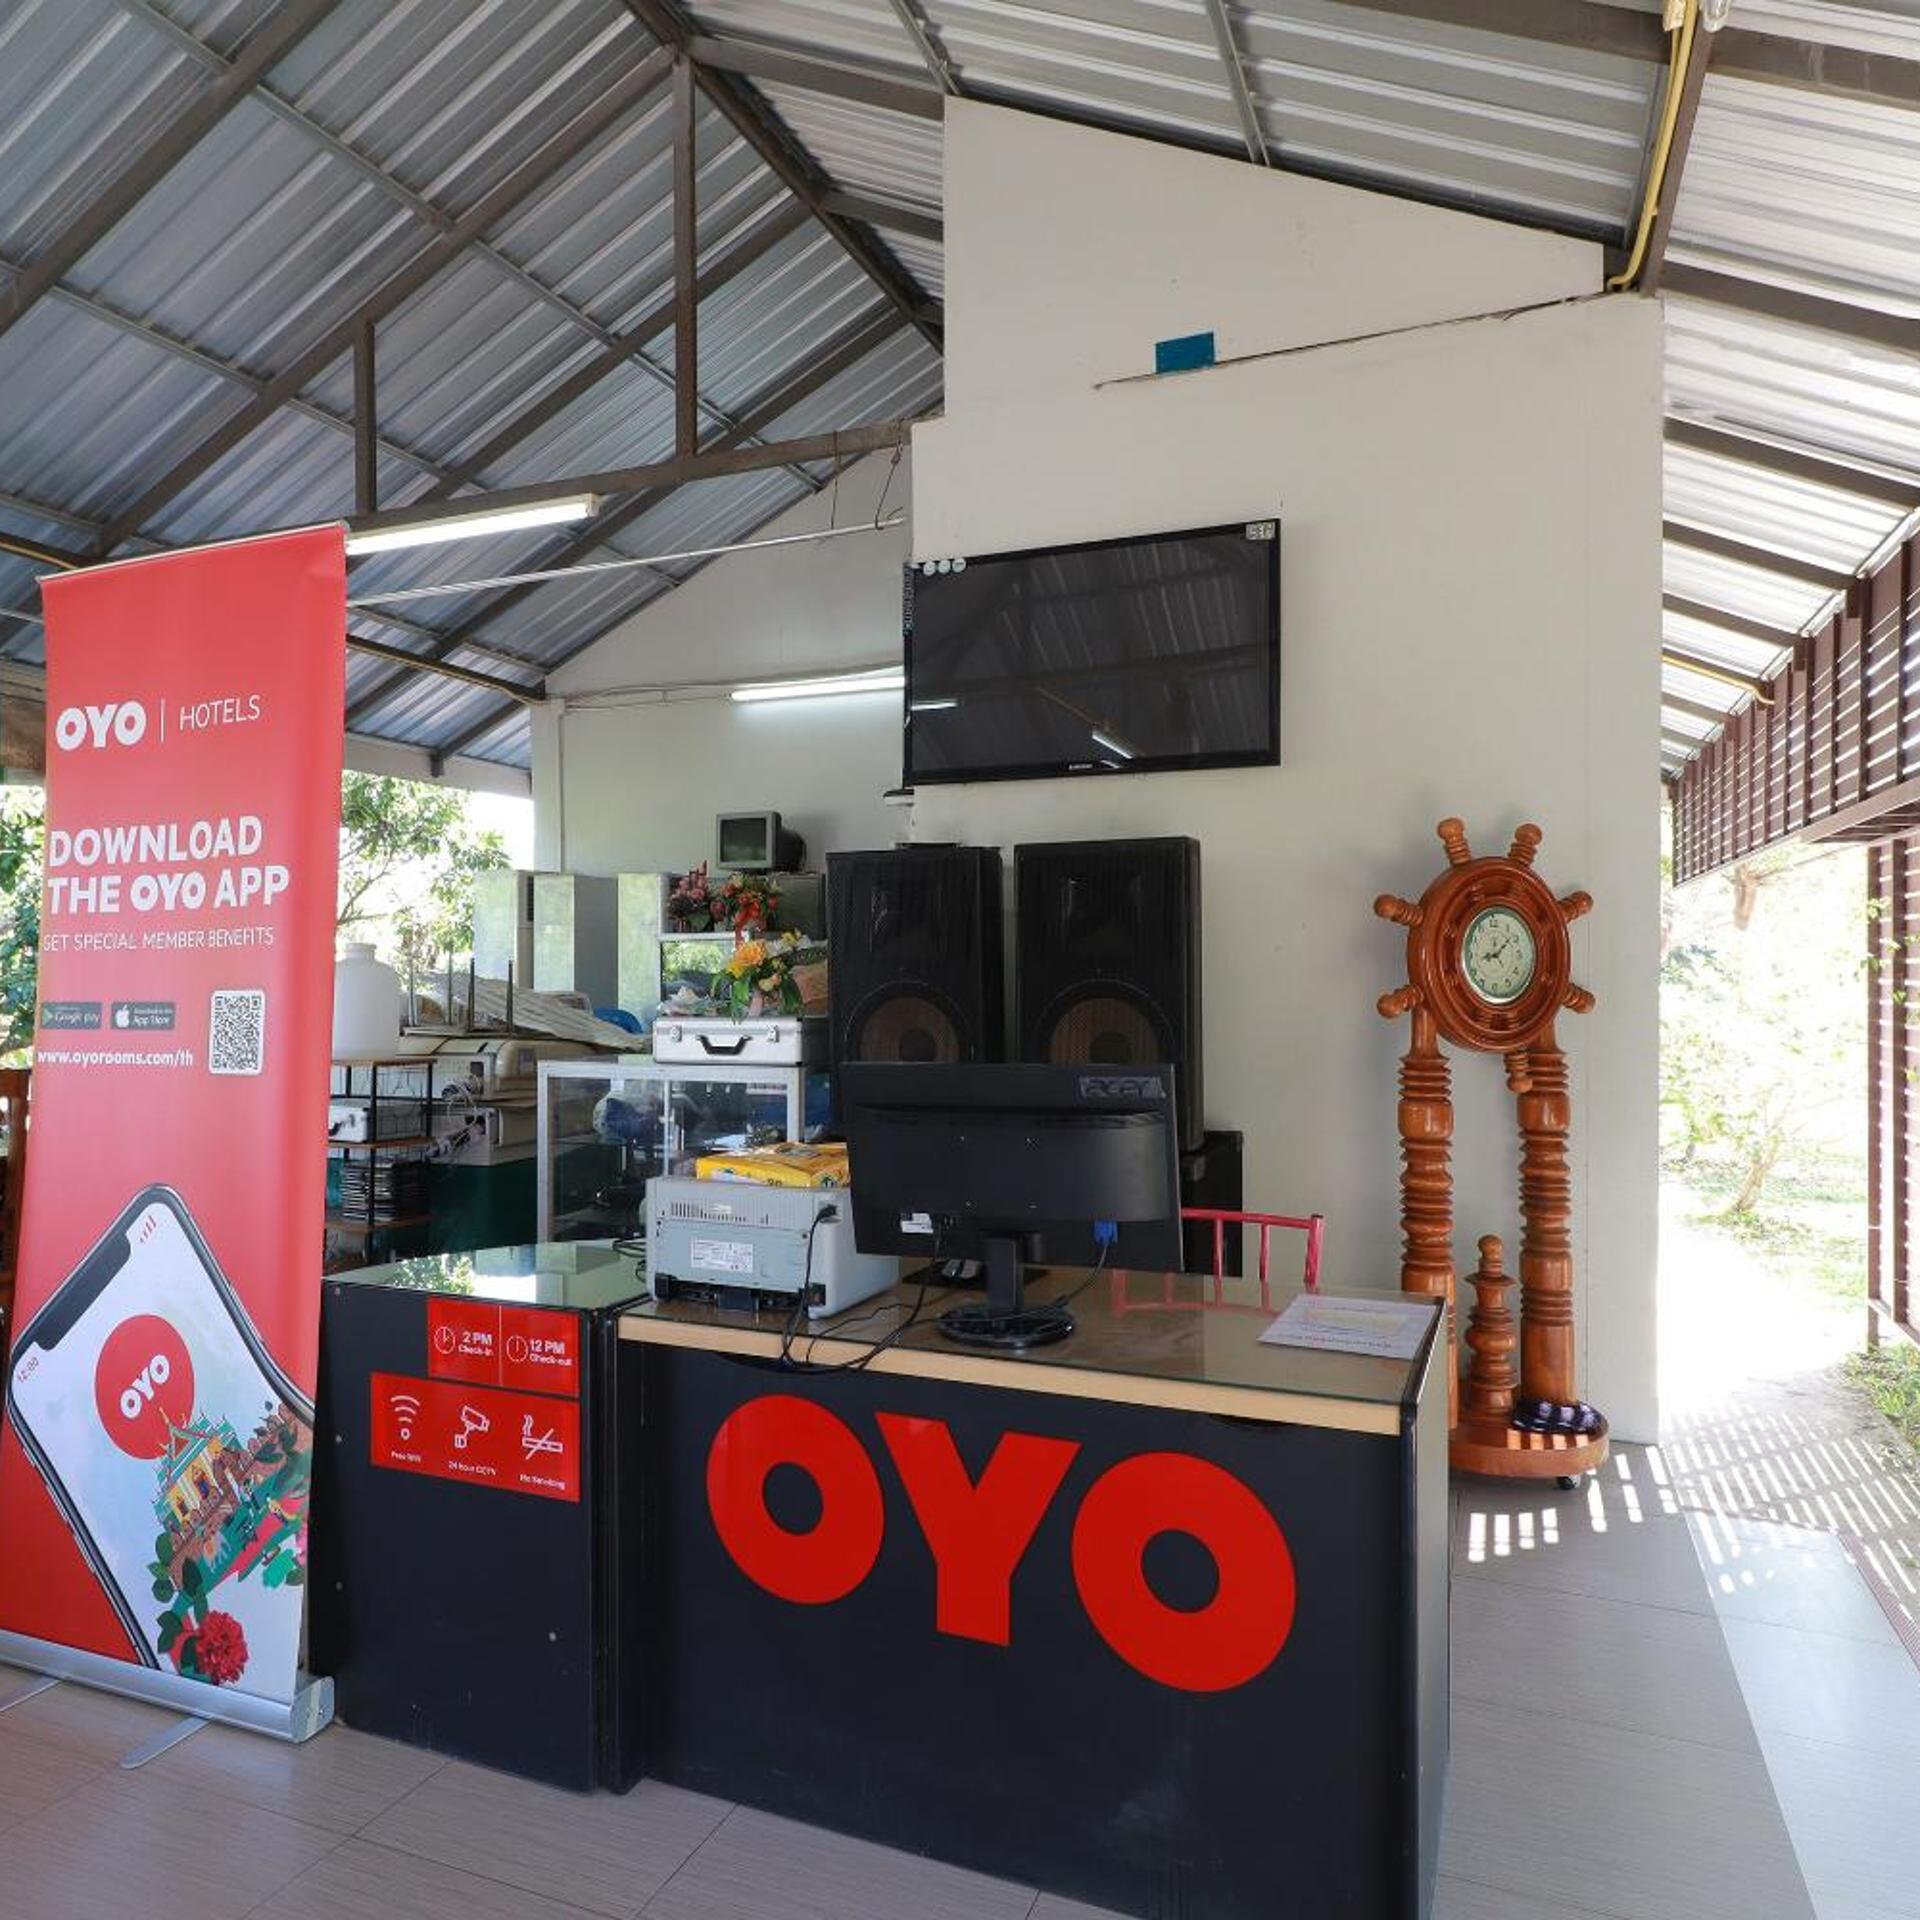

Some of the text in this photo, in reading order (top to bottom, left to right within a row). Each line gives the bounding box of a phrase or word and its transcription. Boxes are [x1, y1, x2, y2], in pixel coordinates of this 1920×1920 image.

[55, 694, 262, 751] OYO HOTELS
[48, 815, 263, 868] DOWNLOAD
[48, 865, 289, 915] THE OYO APP
[43, 926, 274, 951] GET SPECIAL MEMBER BENEFITS
[38, 1049, 194, 1068] www.oyorooms.com/th
[463, 1331, 493, 1346] 2 PM
[529, 1339, 565, 1355] 12 PM
[120, 1354, 170, 1420] OYO
[706, 1394, 1296, 1692] OYO
